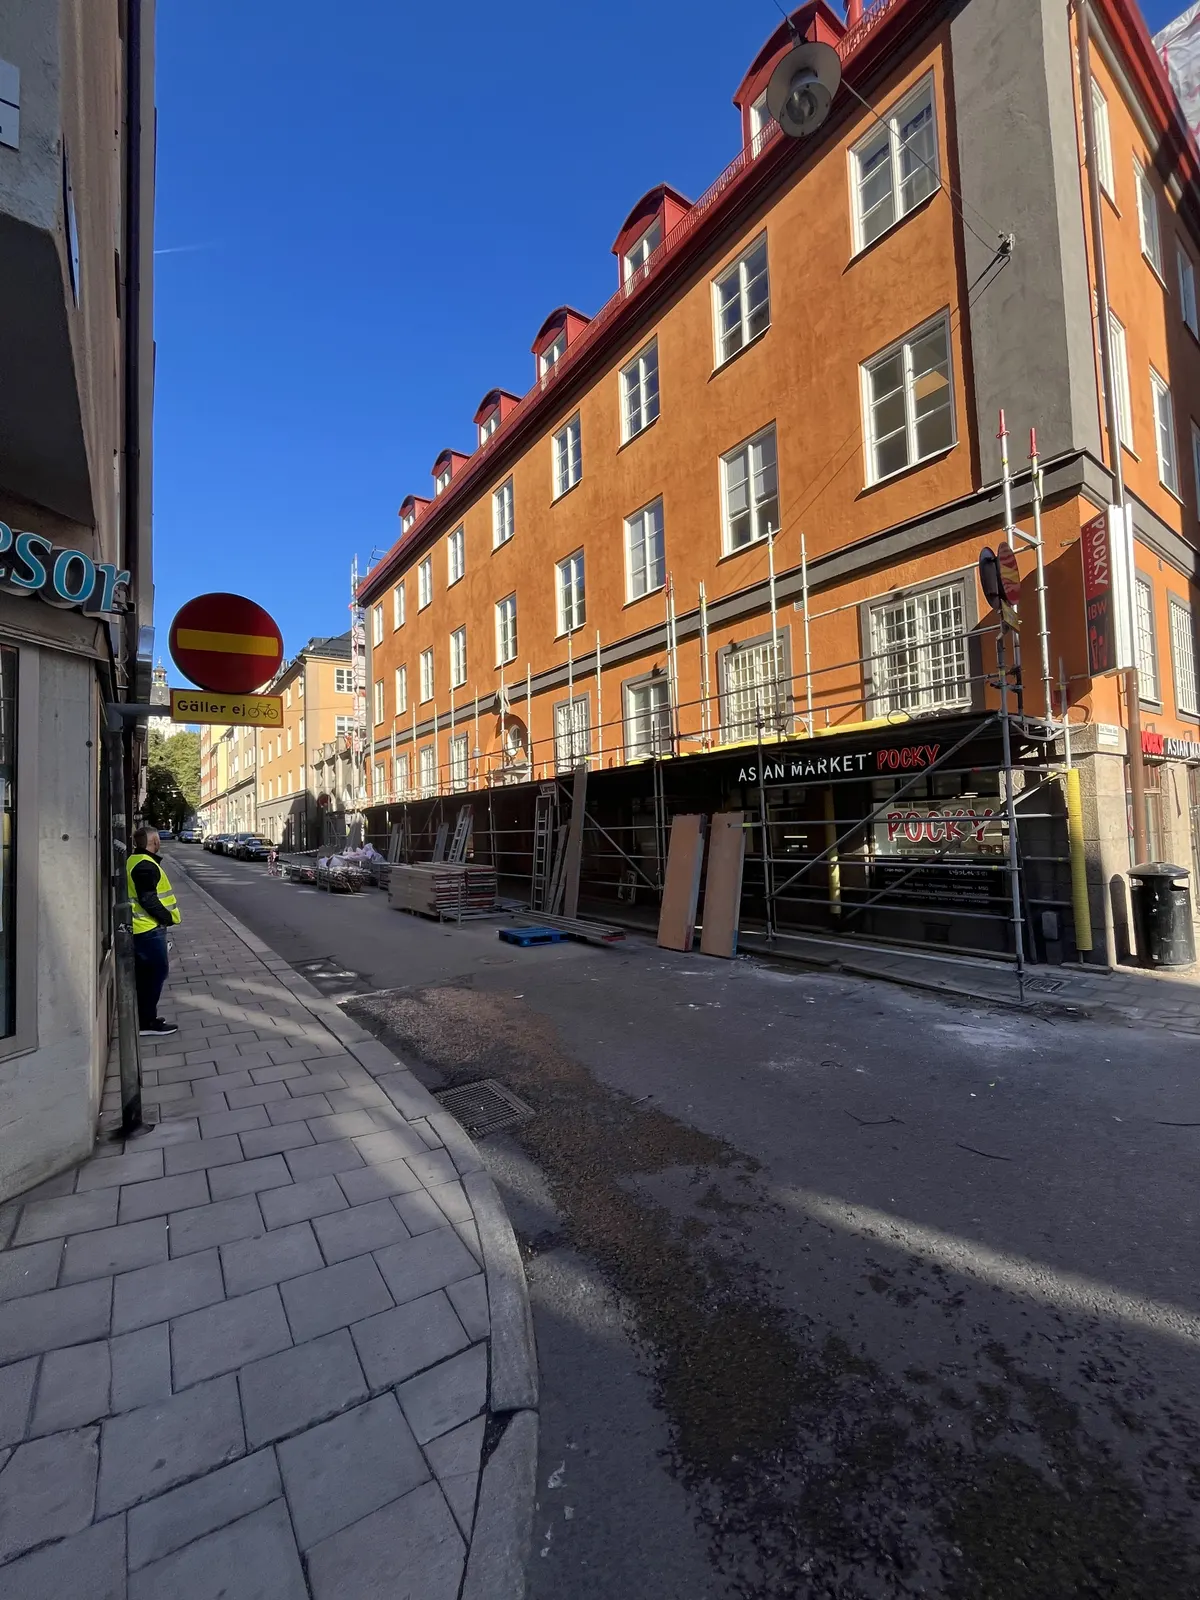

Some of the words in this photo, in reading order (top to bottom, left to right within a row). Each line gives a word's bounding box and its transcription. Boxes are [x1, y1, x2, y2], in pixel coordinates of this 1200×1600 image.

[1091, 516, 1109, 585] POCKY
[177, 700, 227, 713] Gäller
[232, 704, 246, 717] ej
[738, 764, 785, 782] ASAN
[791, 753, 867, 777] MARKET
[876, 744, 940, 770] POCKY
[1167, 738, 1190, 757] ASIAN
[886, 808, 994, 843] POCKY
